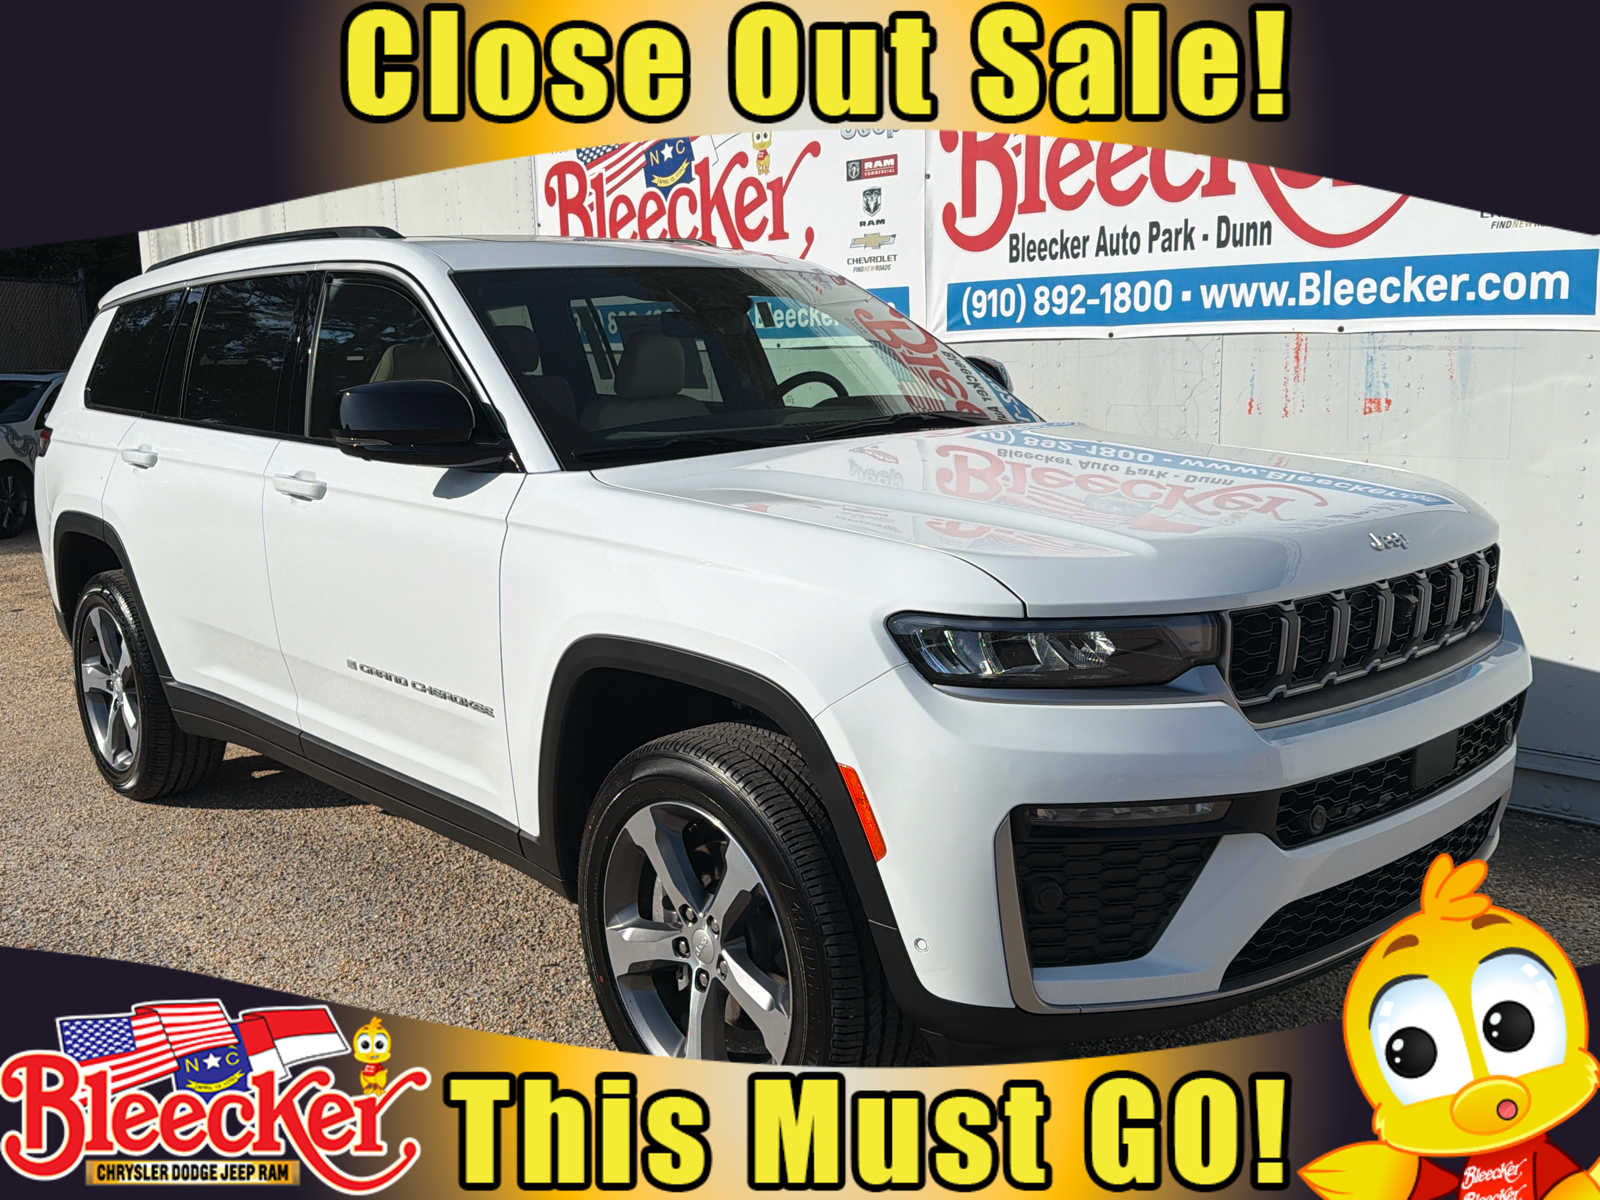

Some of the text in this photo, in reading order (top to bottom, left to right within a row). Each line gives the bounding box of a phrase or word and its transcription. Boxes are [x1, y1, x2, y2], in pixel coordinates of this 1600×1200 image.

[864, 158, 895, 169] RAM
[859, 219, 886, 227] RAM
[1008, 215, 1272, 264] Bleecker Auto Park Dunn
[847, 254, 898, 265] CHEVROLET
[961, 267, 1571, 325] (910) 892-1800 www.Bleecker.com
[1368, 532, 1408, 552] Jeep
[359, 663, 495, 718] GRAND CHEROKEE
